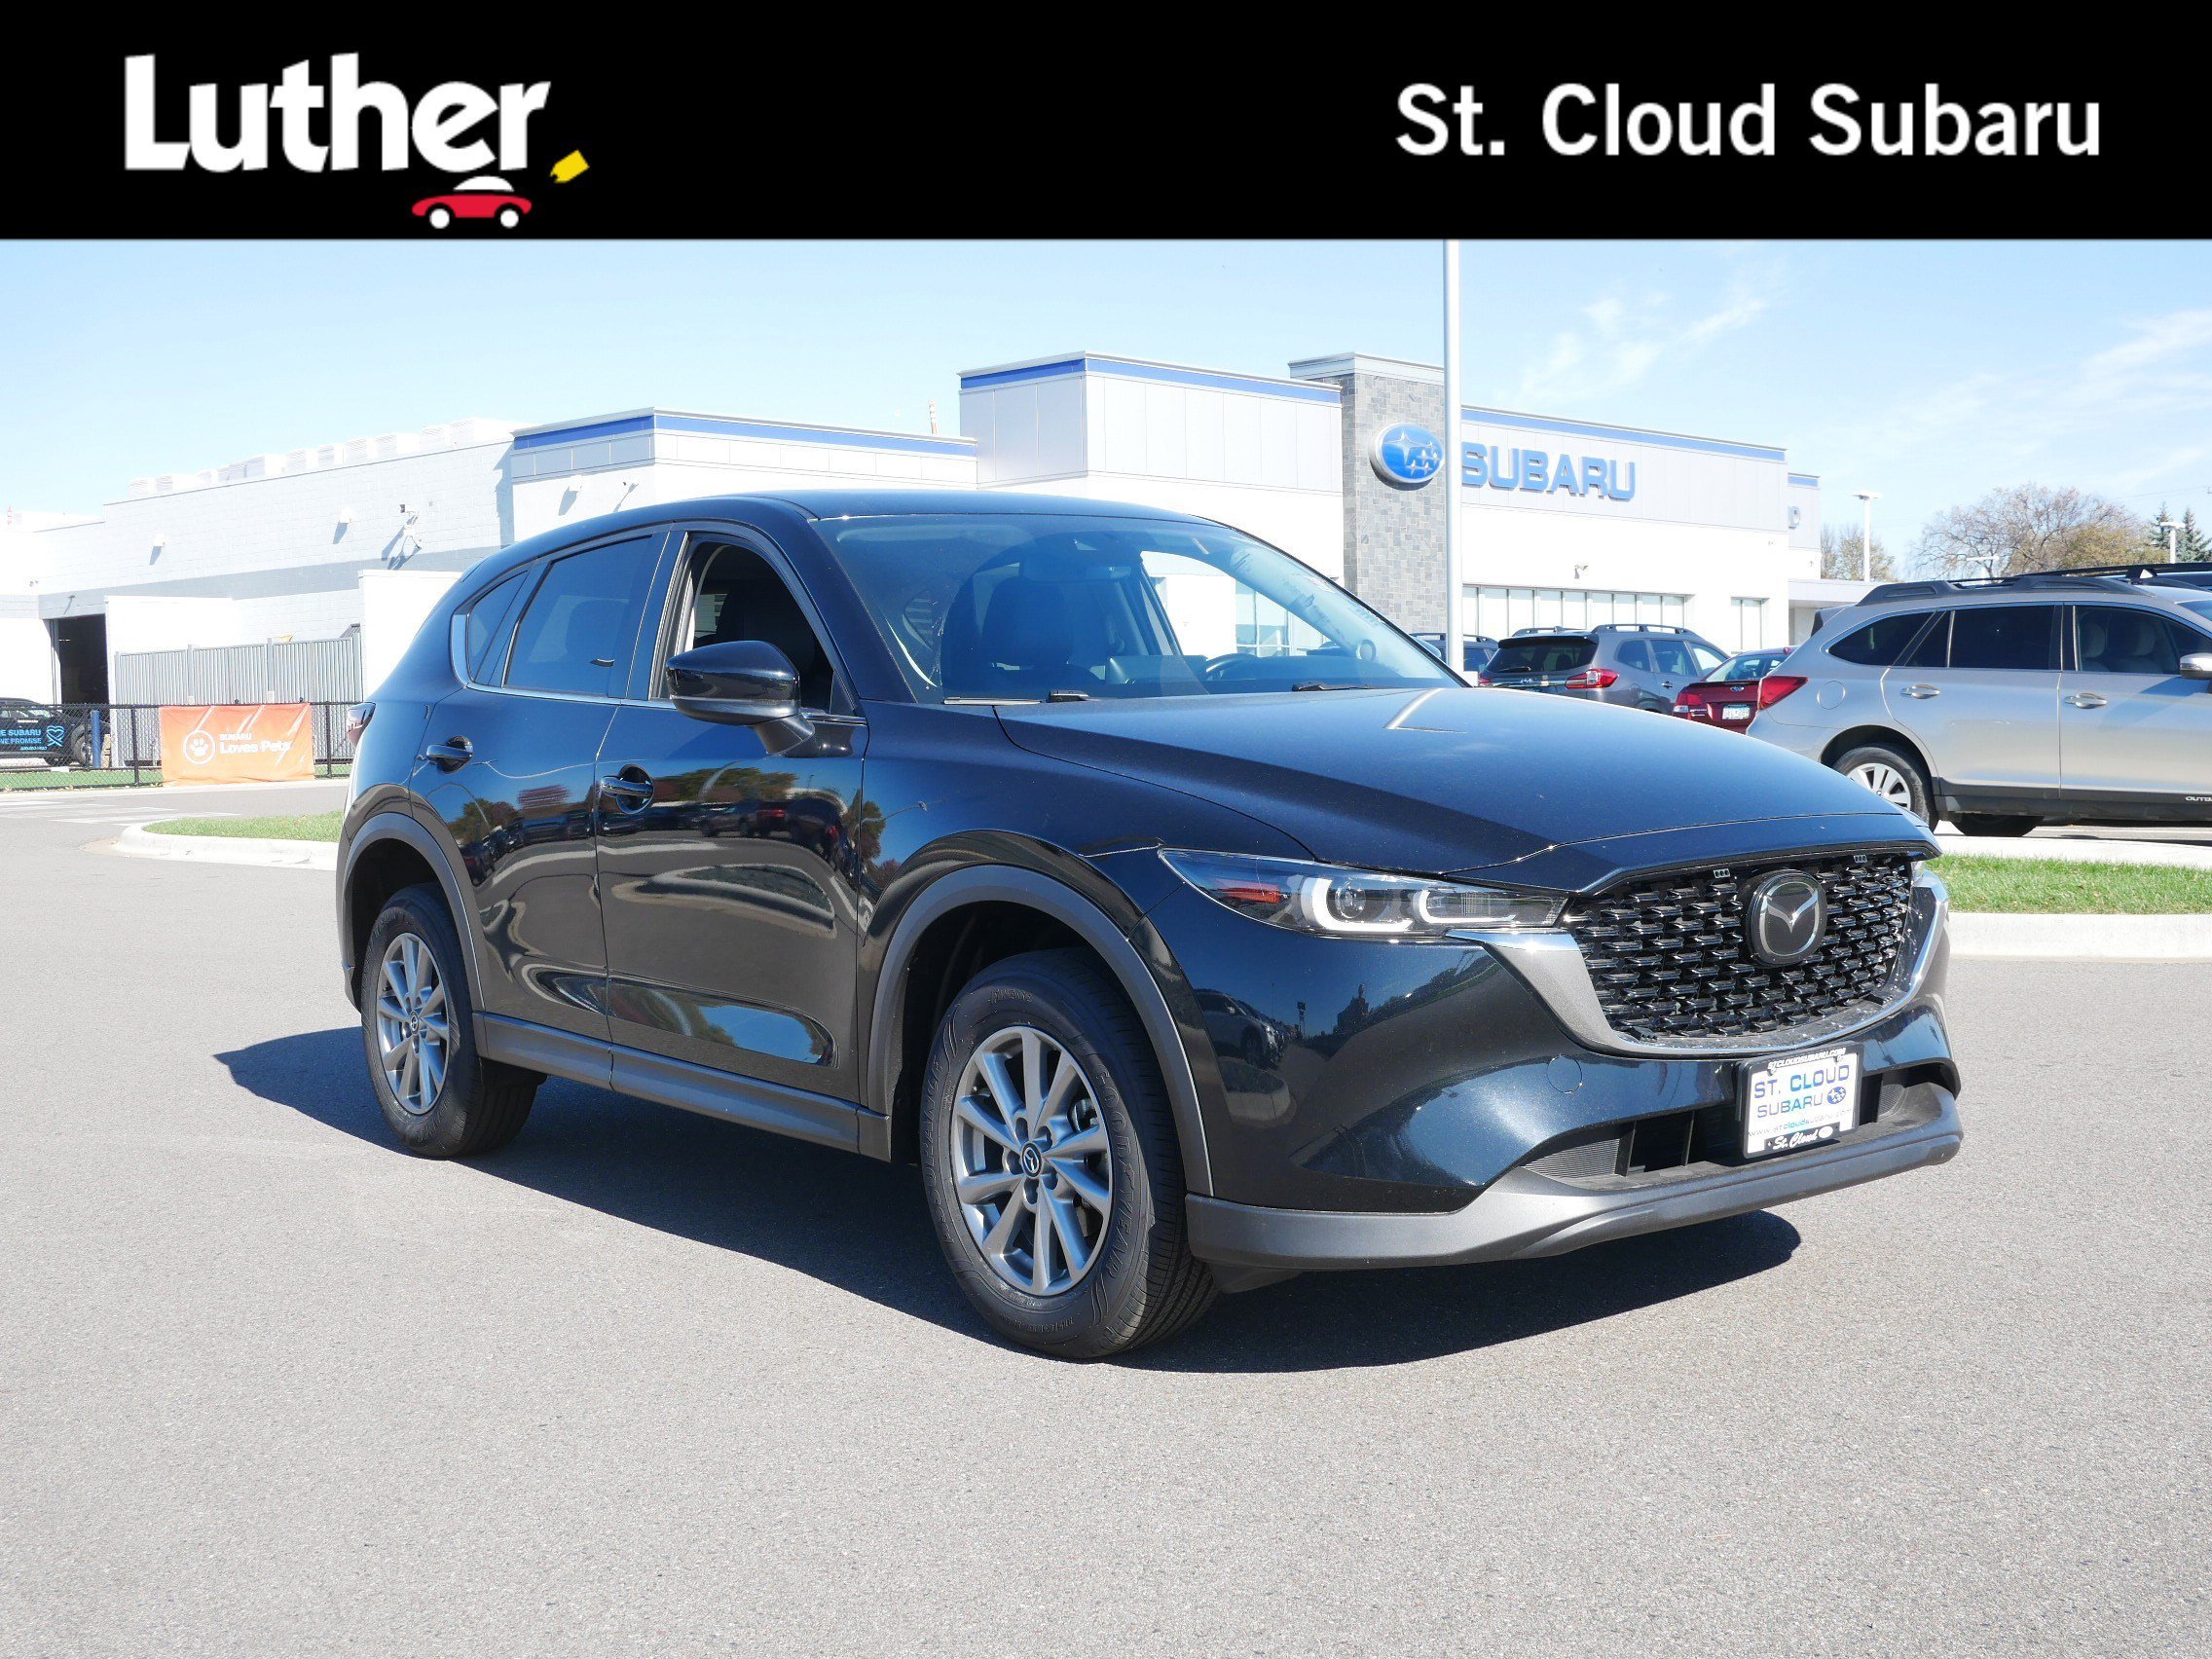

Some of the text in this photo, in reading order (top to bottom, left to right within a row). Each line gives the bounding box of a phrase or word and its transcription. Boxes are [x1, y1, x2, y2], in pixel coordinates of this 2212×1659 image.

[1461, 442, 1636, 501] SUBARU
[219, 740, 292, 755] Loves Pets
[1754, 1065, 1850, 1099] ST. CLOUD
[1756, 1093, 1824, 1119] SUBARU
[1788, 1129, 1820, 1149] Cloud
